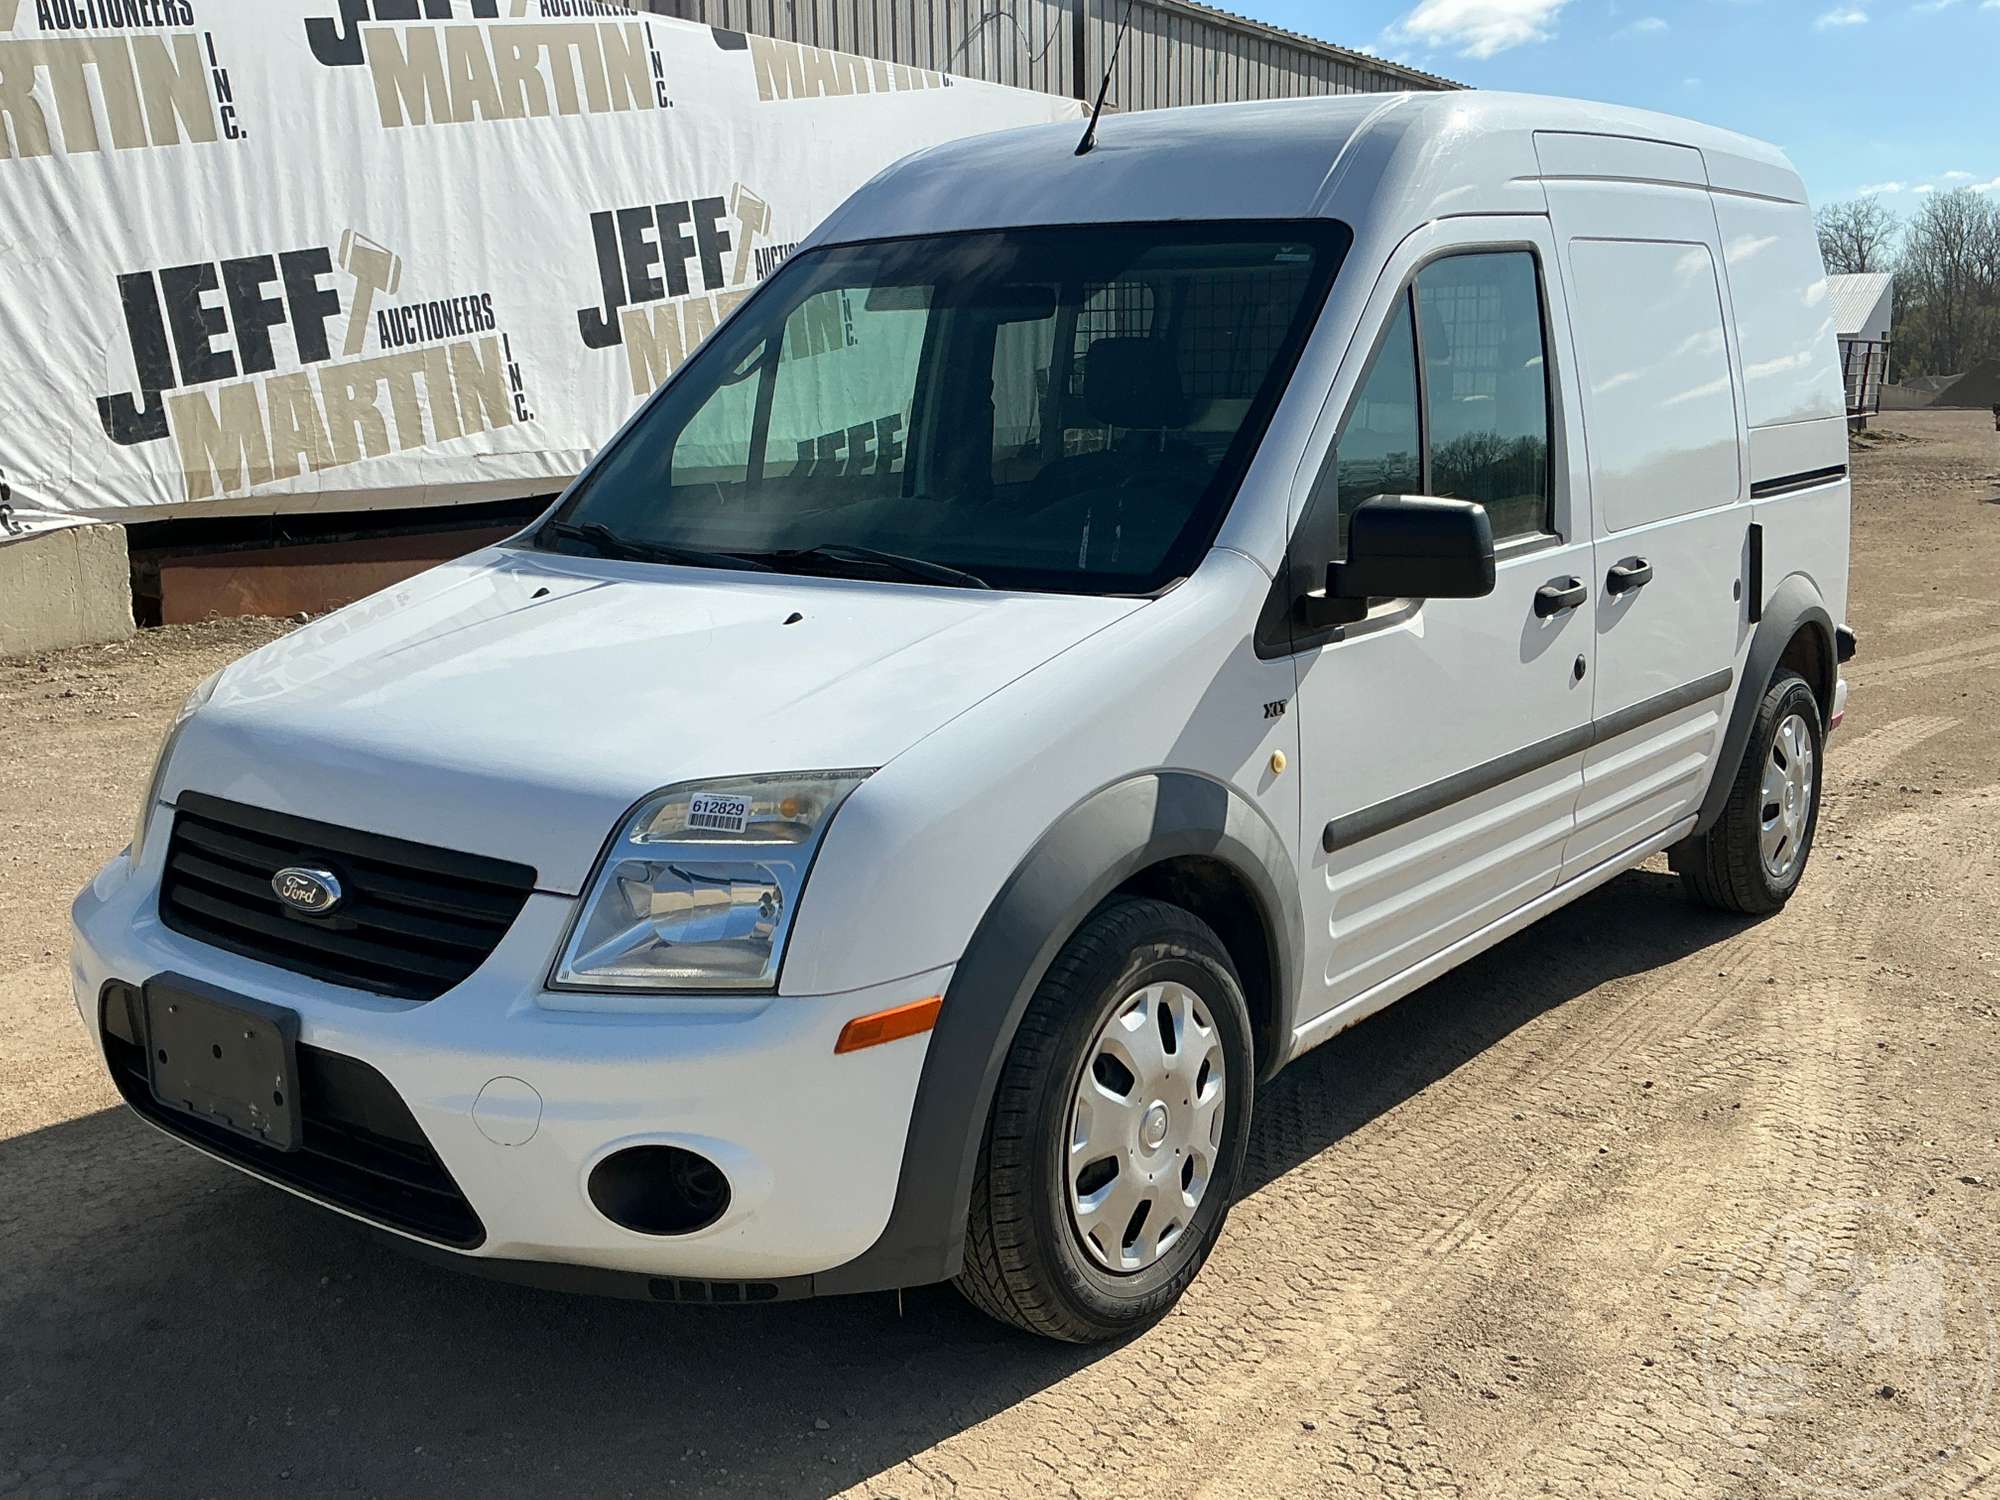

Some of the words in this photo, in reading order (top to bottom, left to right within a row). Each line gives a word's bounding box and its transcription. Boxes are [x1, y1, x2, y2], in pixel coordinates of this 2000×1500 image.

[204, 31, 247, 140] INC.
[363, 22, 654, 128] MARTIN
[645, 21, 673, 108] INC.
[377, 292, 497, 350] AUCTIONEERS
[577, 196, 733, 350] JEFF
[96, 247, 341, 446] JEFF
[502, 332, 535, 422] INC.
[167, 336, 514, 501] MARTIN
[692, 800, 745, 816] 612829
[282, 875, 317, 904] Ford
